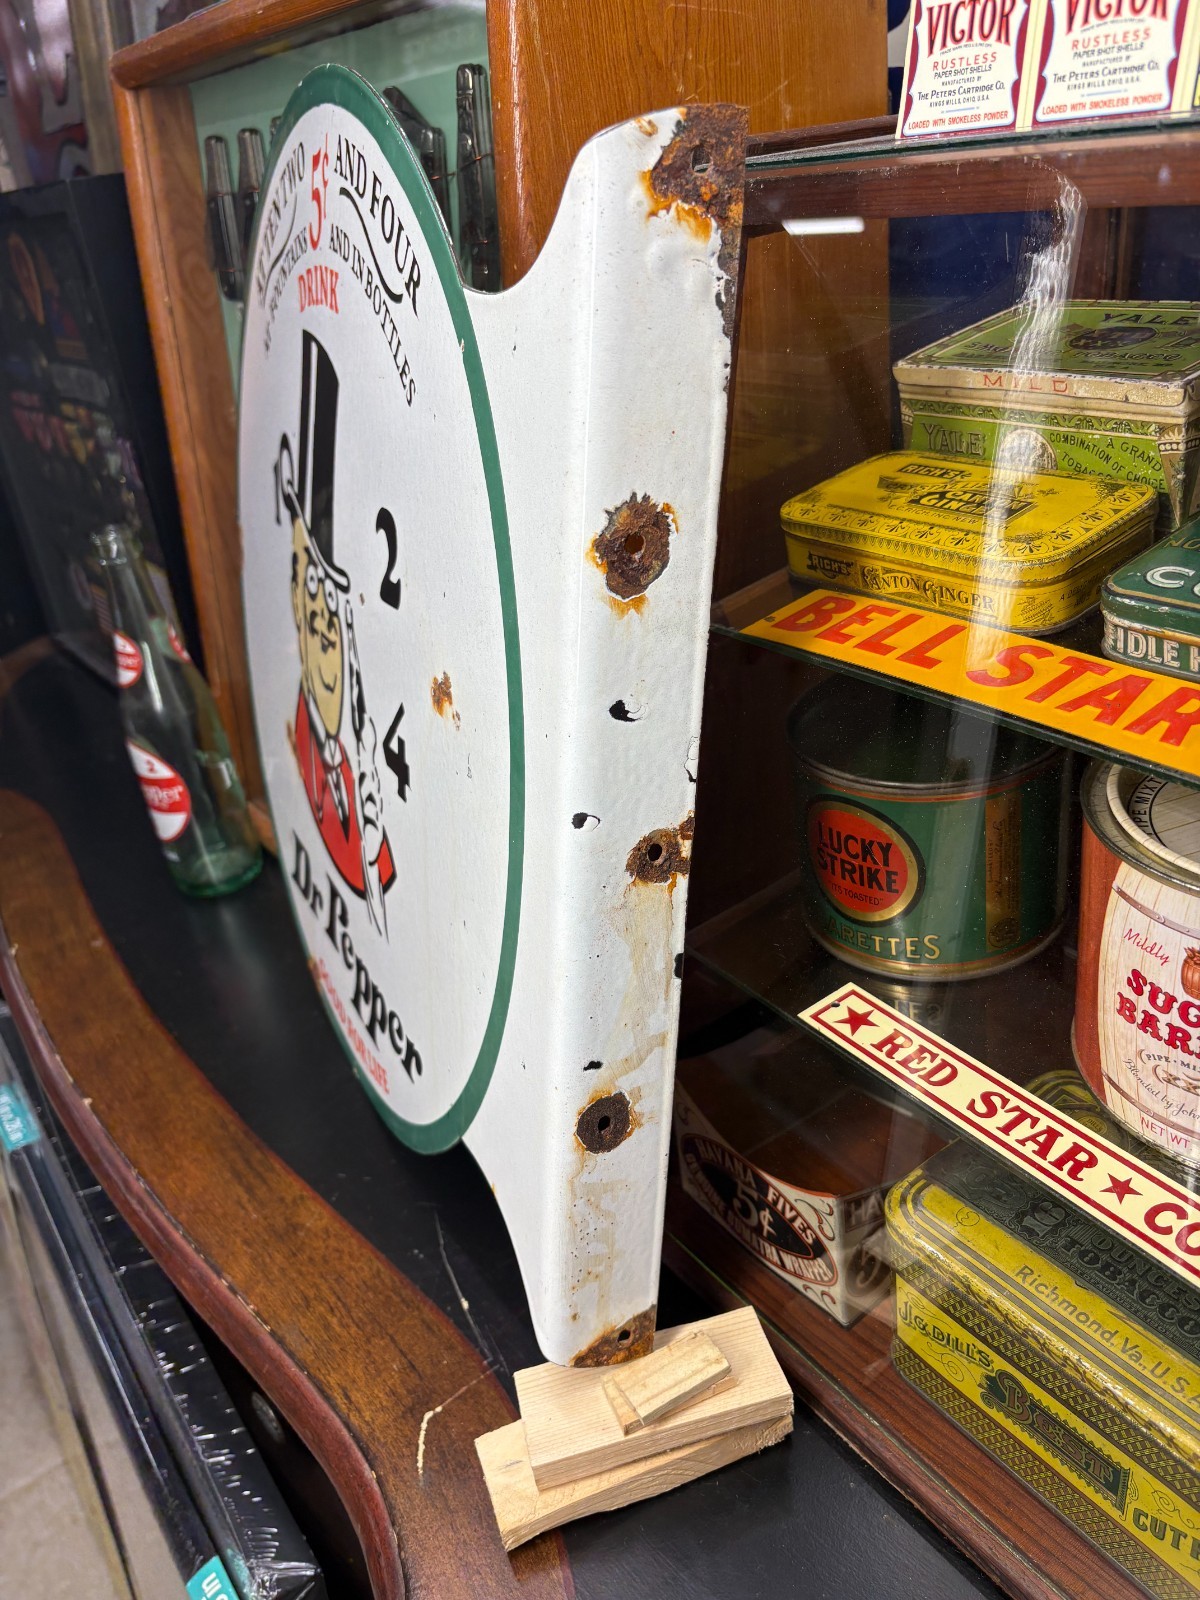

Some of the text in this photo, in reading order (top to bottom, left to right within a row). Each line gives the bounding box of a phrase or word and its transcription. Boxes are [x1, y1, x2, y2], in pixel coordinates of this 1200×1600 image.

[927, 0, 1012, 58] VICTOR
[1071, 27, 1152, 51] RUSTLESS
[932, 52, 998, 72] RUSTLESS
[934, 64, 993, 80] PAPER SHOT SHELLS
[1072, 42, 1145, 60] PAPER SHOT SHELLS
[930, 89, 957, 99] PETERS
[957, 83, 994, 96] CARTRIDGE
[1068, 71, 1099, 82] PETERS
[1101, 64, 1146, 78] CARTRIDGE
[908, 110, 1009, 130] LOADED WITH SMOKELESS POWDER
[929, 100, 945, 108] KINGS
[1042, 93, 1163, 116] LOADED WITH SMOKELESS POWDER
[280, 141, 306, 209] TWO
[334, 134, 367, 199] AND
[370, 170, 421, 318] FOUR
[298, 264, 339, 315] DRINK
[329, 223, 350, 264] AND
[352, 244, 367, 281] IN
[365, 266, 417, 408] BOTTLES
[1101, 313, 1199, 325] YALE
[920, 422, 986, 457] YALE
[1106, 438, 1162, 473] A GRAND
[900, 464, 959, 479] RICH'S
[1050, 432, 1166, 491] COMBINATION OF CHOICE
[1062, 451, 1113, 480] TOBA
[945, 490, 1022, 511] CANN
[376, 506, 401, 610] 2
[810, 555, 849, 577] RICH'S
[861, 565, 923, 593] CANTON
[922, 578, 996, 613] GINGER
[1116, 626, 1181, 669] IDLE
[772, 594, 1200, 747] BELL STAR
[382, 702, 412, 803] 4
[818, 820, 893, 867] LUCKY
[817, 846, 900, 894] STRIKE
[292, 828, 423, 1085] Dr Pepper
[1124, 928, 1170, 966] Mildly
[1116, 991, 1200, 1060] BAR
[1123, 1058, 1161, 1098] Blended
[1161, 1094, 1174, 1110] by
[1145, 1053, 1200, 1074] PIPE MI
[872, 1027, 960, 1089] RED
[967, 1090, 1099, 1182] STAR
[1140, 1116, 1166, 1137] NET
[695, 1137, 817, 1247] HAVANA FIVES
[780, 1251, 834, 1282] WRAPPER
[1059, 1236, 1200, 1338] TOBACCO
[1090, 1232, 1200, 1311] OUNCES
[1014, 1263, 1119, 1348] Richmond,
[995, 1368, 1115, 1485] BEST
[1132, 1507, 1188, 1551] CUT
